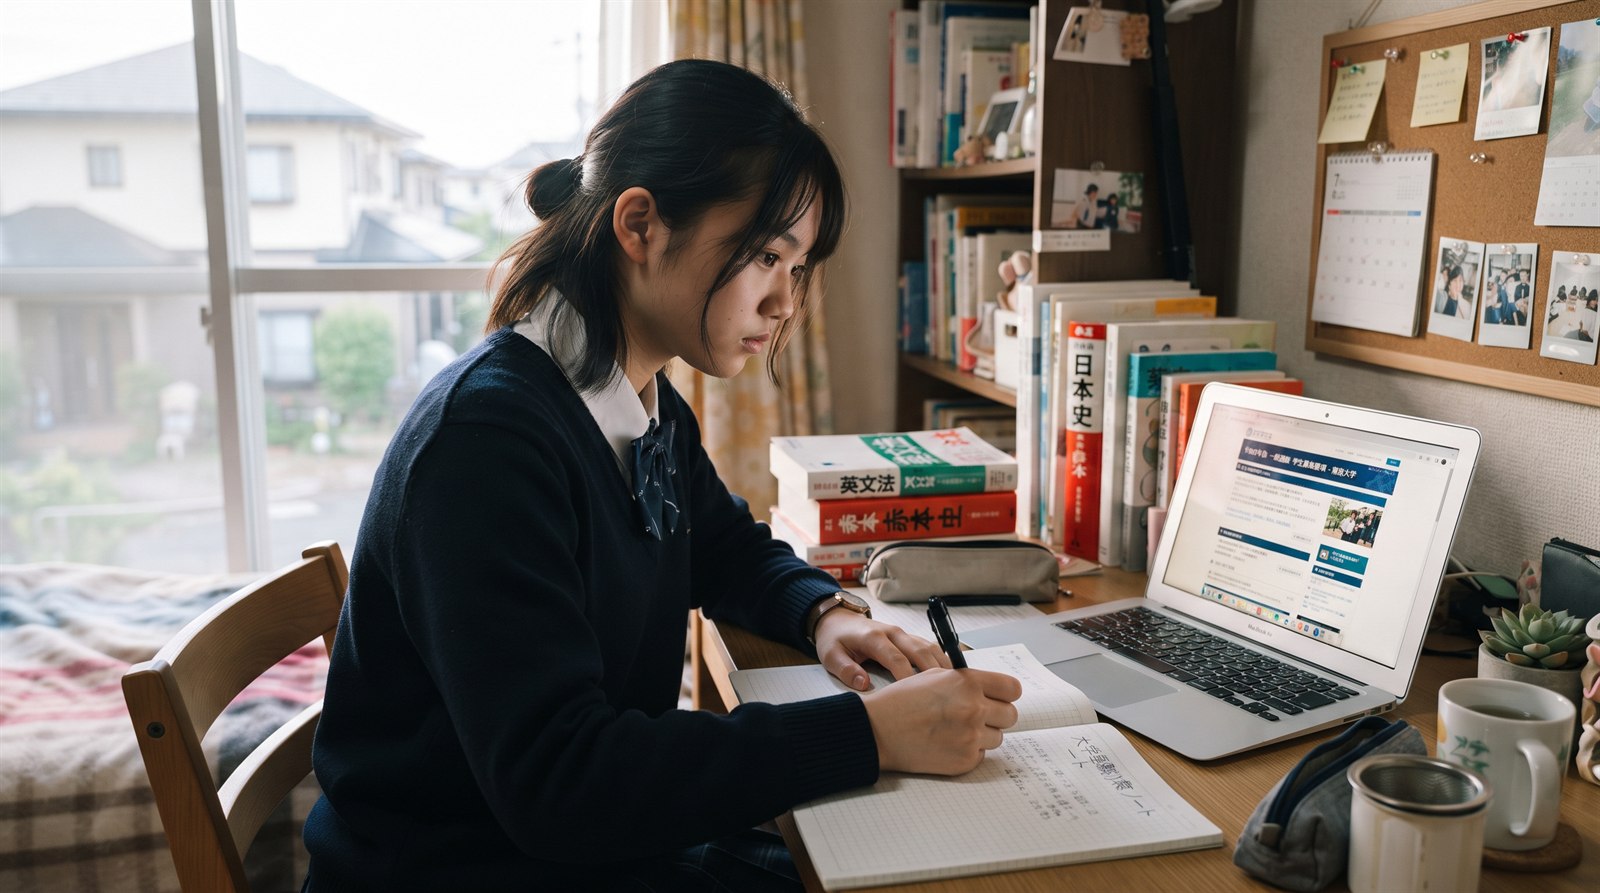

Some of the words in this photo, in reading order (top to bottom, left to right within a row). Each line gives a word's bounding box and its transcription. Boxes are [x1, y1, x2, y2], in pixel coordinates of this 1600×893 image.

[1073, 354, 1093, 428] 日本史
[840, 475, 895, 494] 英文法
[838, 512, 879, 535] 赤本
